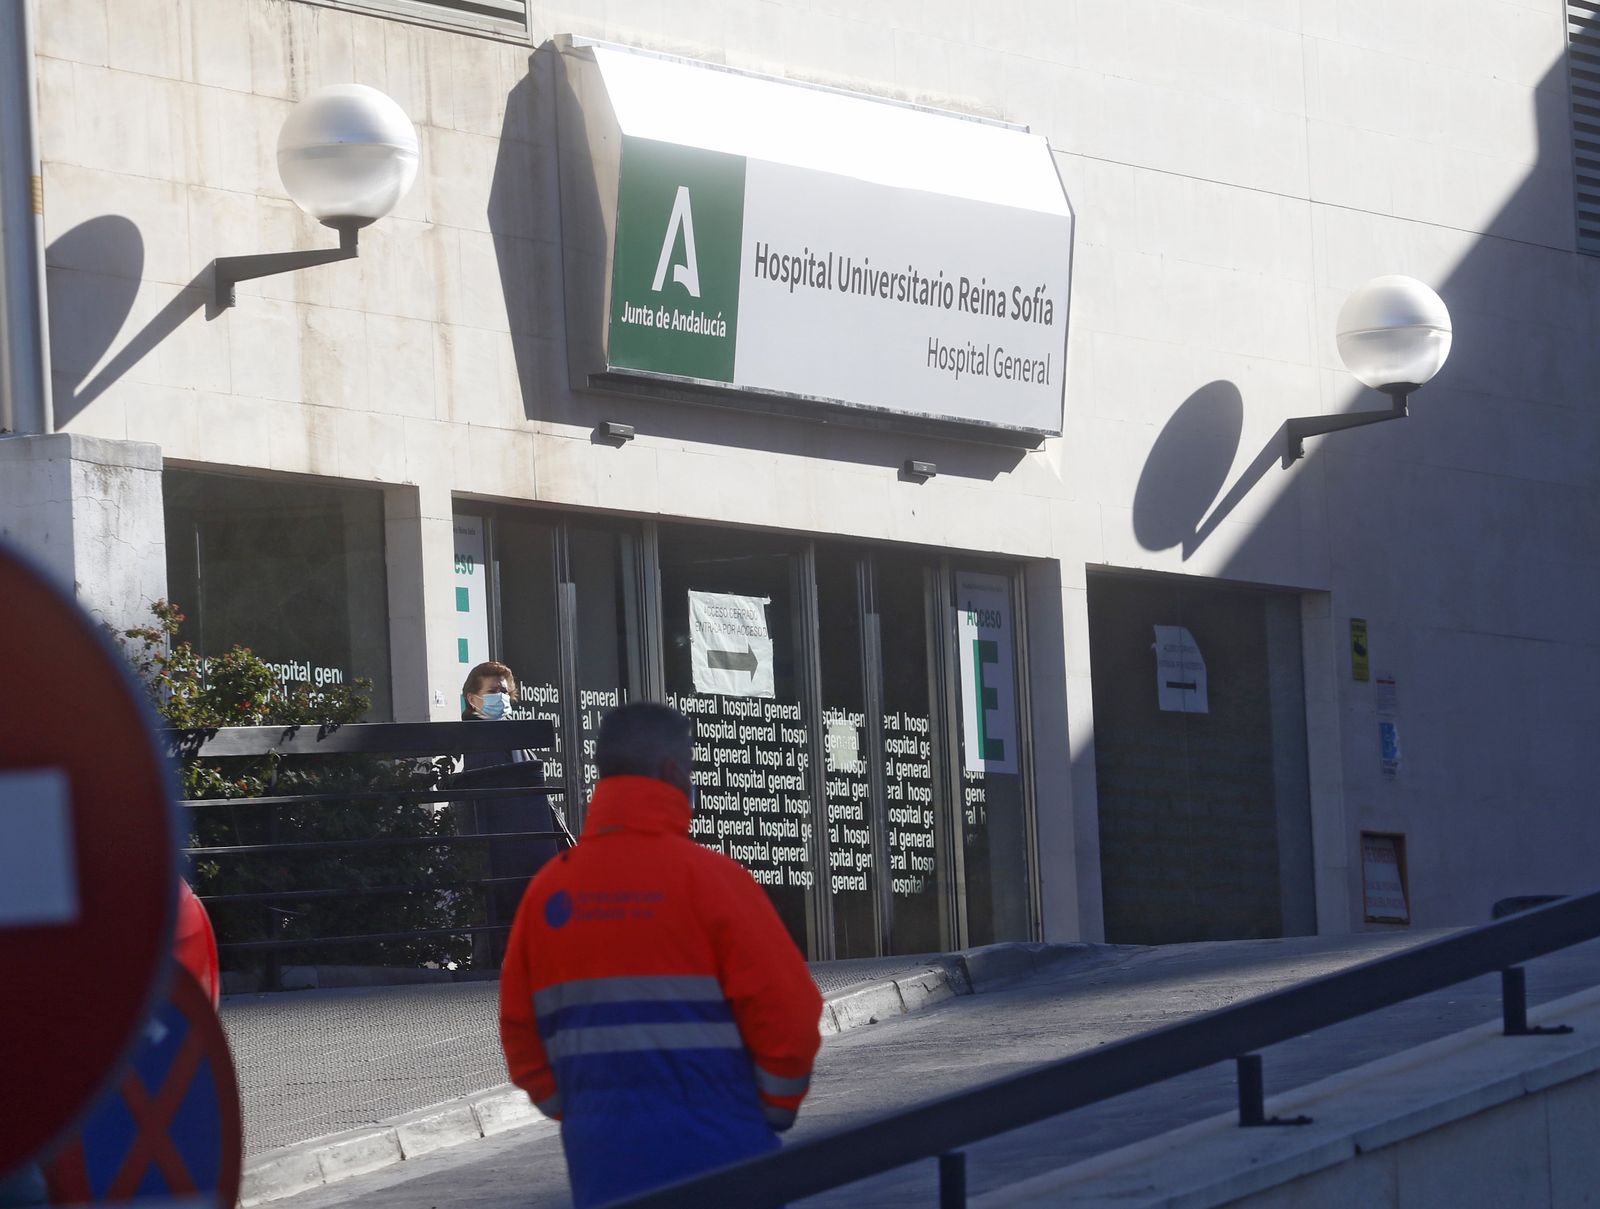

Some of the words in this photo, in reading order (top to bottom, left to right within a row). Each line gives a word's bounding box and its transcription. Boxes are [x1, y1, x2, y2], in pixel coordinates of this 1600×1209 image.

[754, 242, 833, 293] Hospital
[837, 256, 953, 310] Universitario
[958, 276, 1007, 320] Reina
[1011, 282, 1054, 327] Sofía
[621, 301, 653, 327] Junta
[655, 305, 670, 330] de
[671, 308, 727, 338] Andalucía
[927, 337, 990, 377] Hospital
[993, 347, 1051, 386] General
[966, 600, 1002, 629] Acceso
[723, 623, 736, 635] POR
[314, 667, 343, 688] gen
[520, 681, 559, 707] hospita
[580, 688, 618, 710] general
[973, 639, 1005, 762] E
[680, 694, 718, 716] general
[722, 695, 762, 721] hospital
[764, 701, 801, 723] general
[697, 717, 737, 743] hospital
[739, 722, 776, 745] general
[781, 723, 808, 748] hospi
[713, 745, 751, 768] general
[584, 762, 599, 784] ge
[726, 768, 766, 792] hospital
[768, 771, 804, 796] general
[896, 760, 931, 781] general
[701, 790, 740, 814] hospital
[742, 793, 780, 816] general
[784, 794, 811, 818] hospi
[852, 782, 870, 802] gen
[828, 801, 864, 824] general
[717, 816, 755, 839] general
[759, 816, 799, 841] hospital
[843, 824, 870, 848] hospi
[899, 829, 935, 851] general
[729, 840, 770, 865] hospital
[772, 843, 809, 866] general
[855, 851, 873, 872] gen
[748, 865, 784, 885] eneral
[831, 872, 867, 895] general
